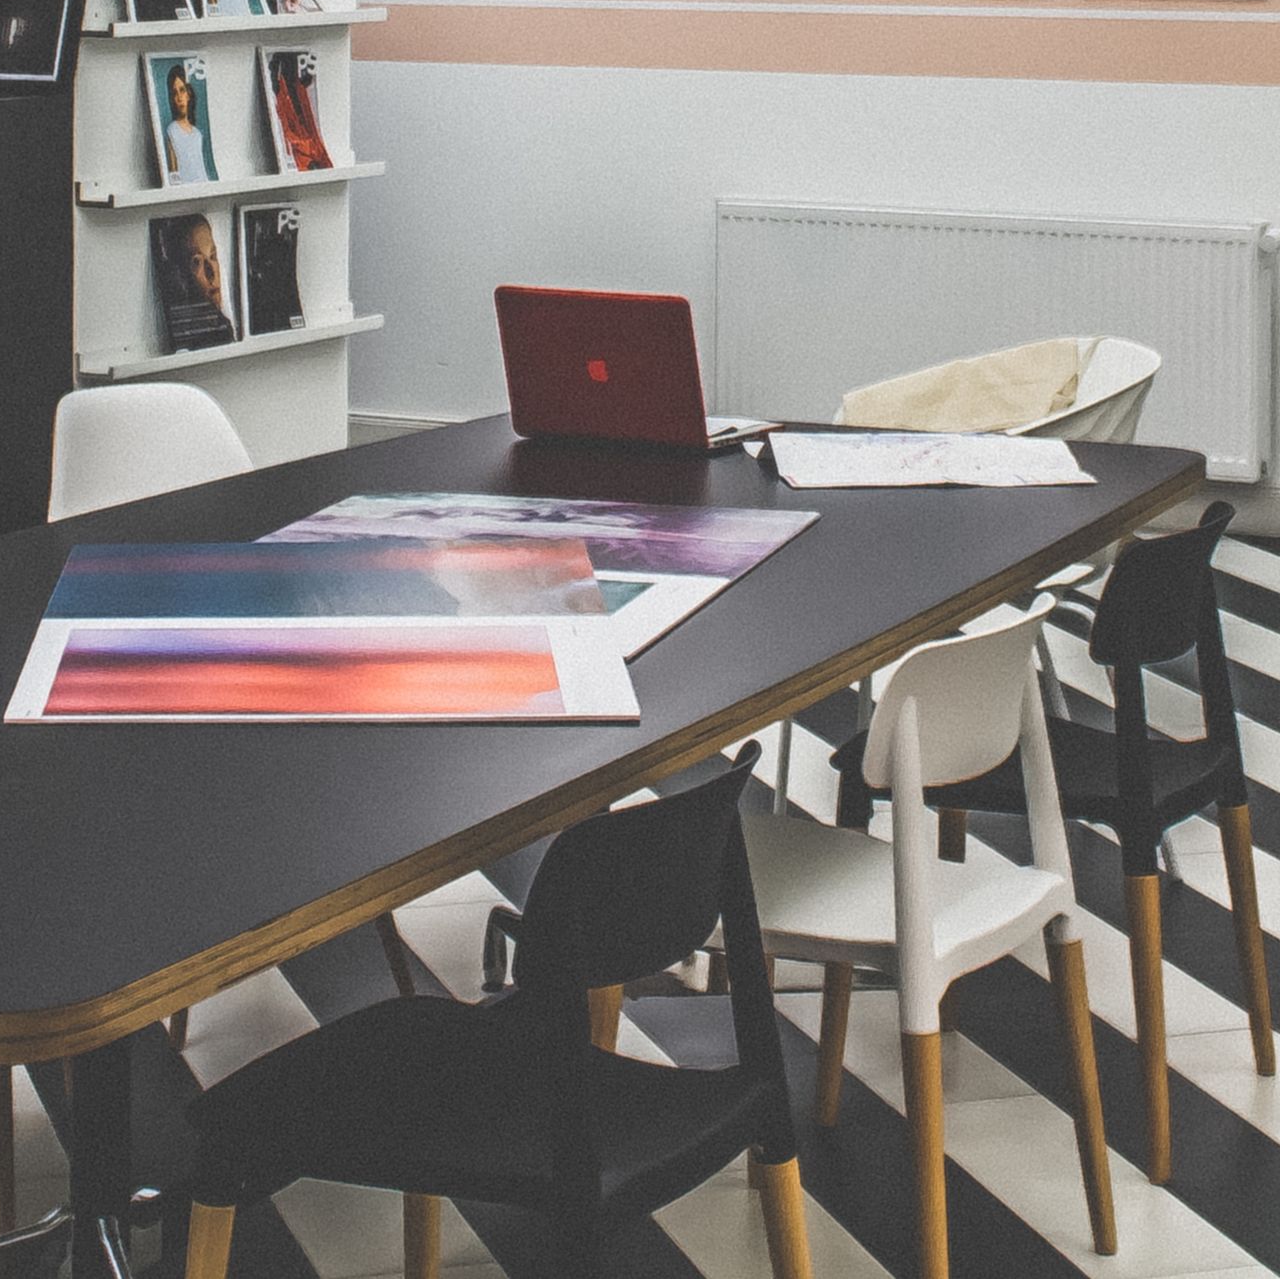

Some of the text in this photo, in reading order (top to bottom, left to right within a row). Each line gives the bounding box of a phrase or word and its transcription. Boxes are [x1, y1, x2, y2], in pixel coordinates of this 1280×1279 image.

[183, 55, 208, 84] PS
[297, 51, 318, 78] PS
[278, 209, 301, 235] PS
